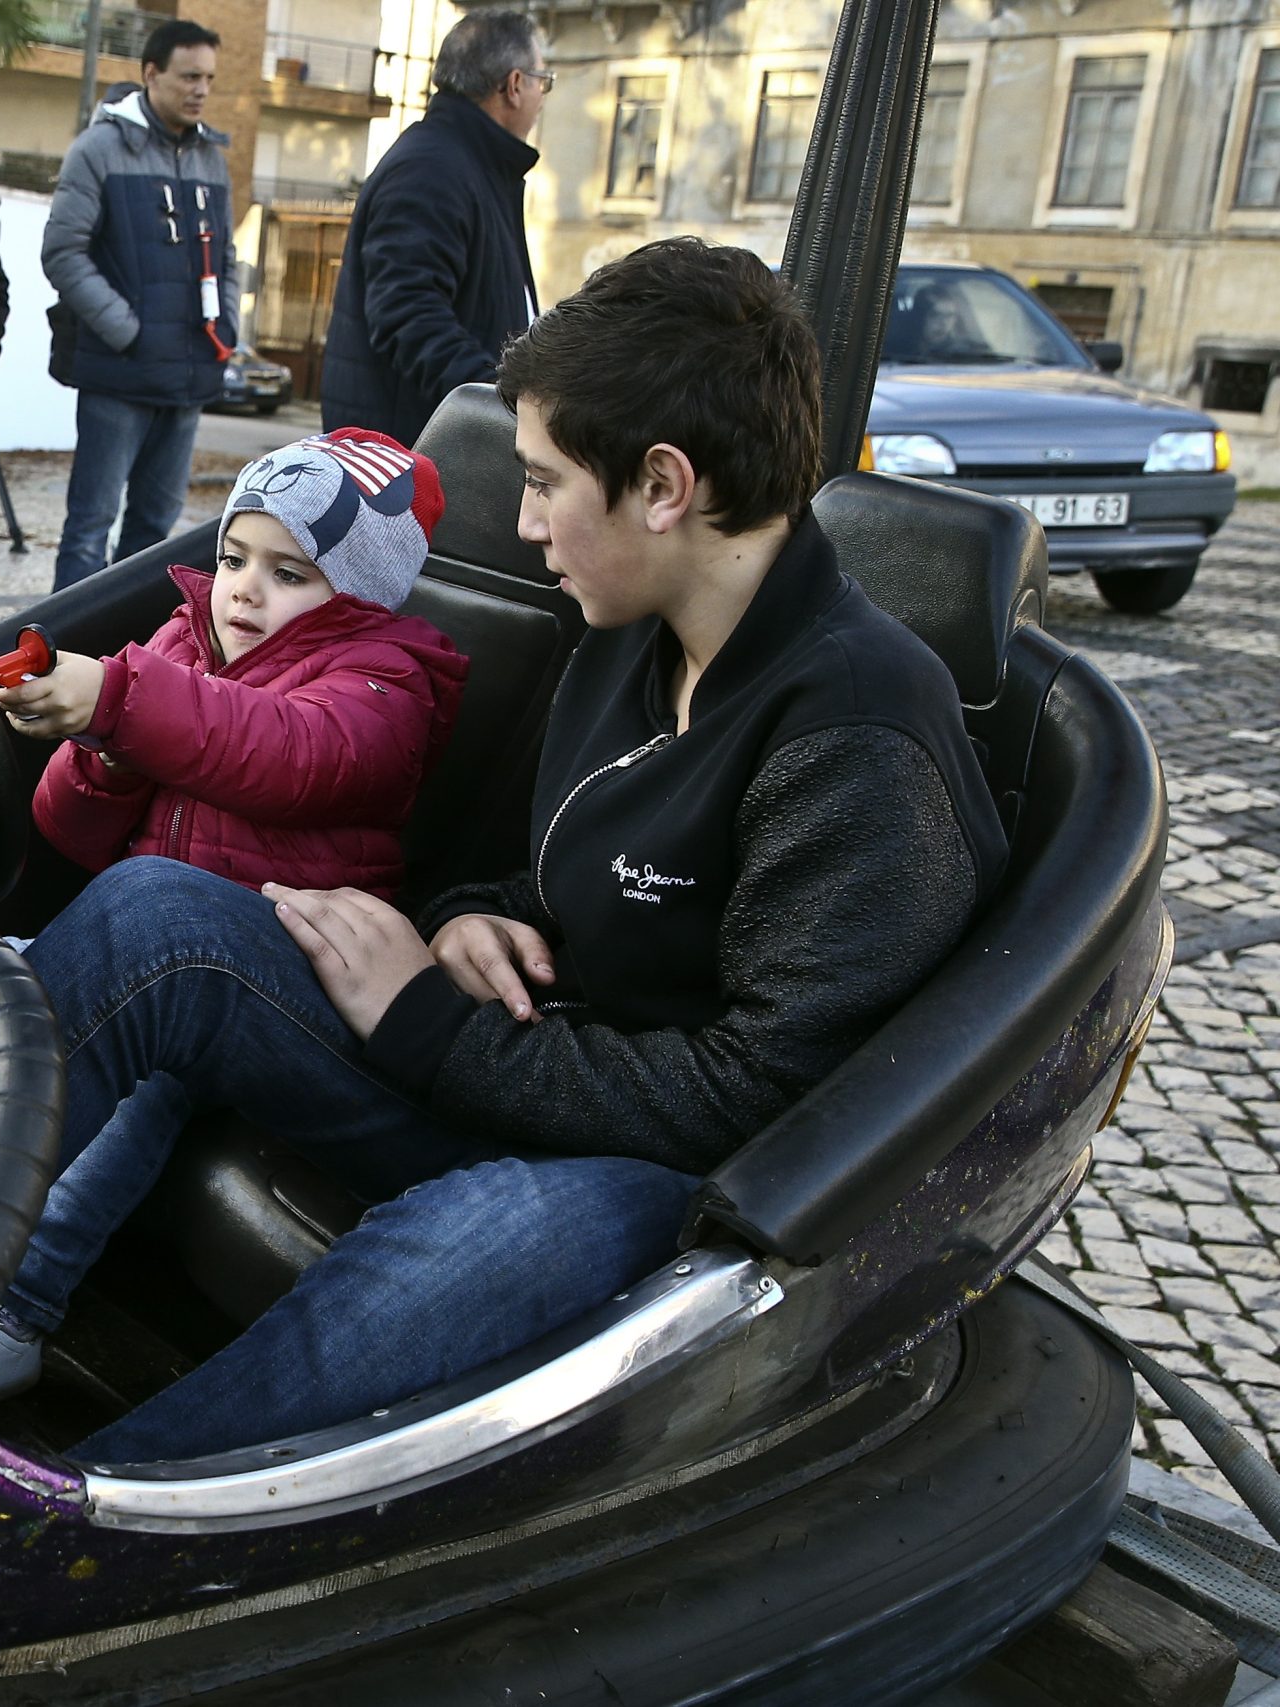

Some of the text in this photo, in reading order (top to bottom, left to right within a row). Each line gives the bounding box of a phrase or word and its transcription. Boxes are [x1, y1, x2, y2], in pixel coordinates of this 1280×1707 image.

[611, 854, 696, 889] Pepe Jeans
[623, 888, 661, 904] LONDON
